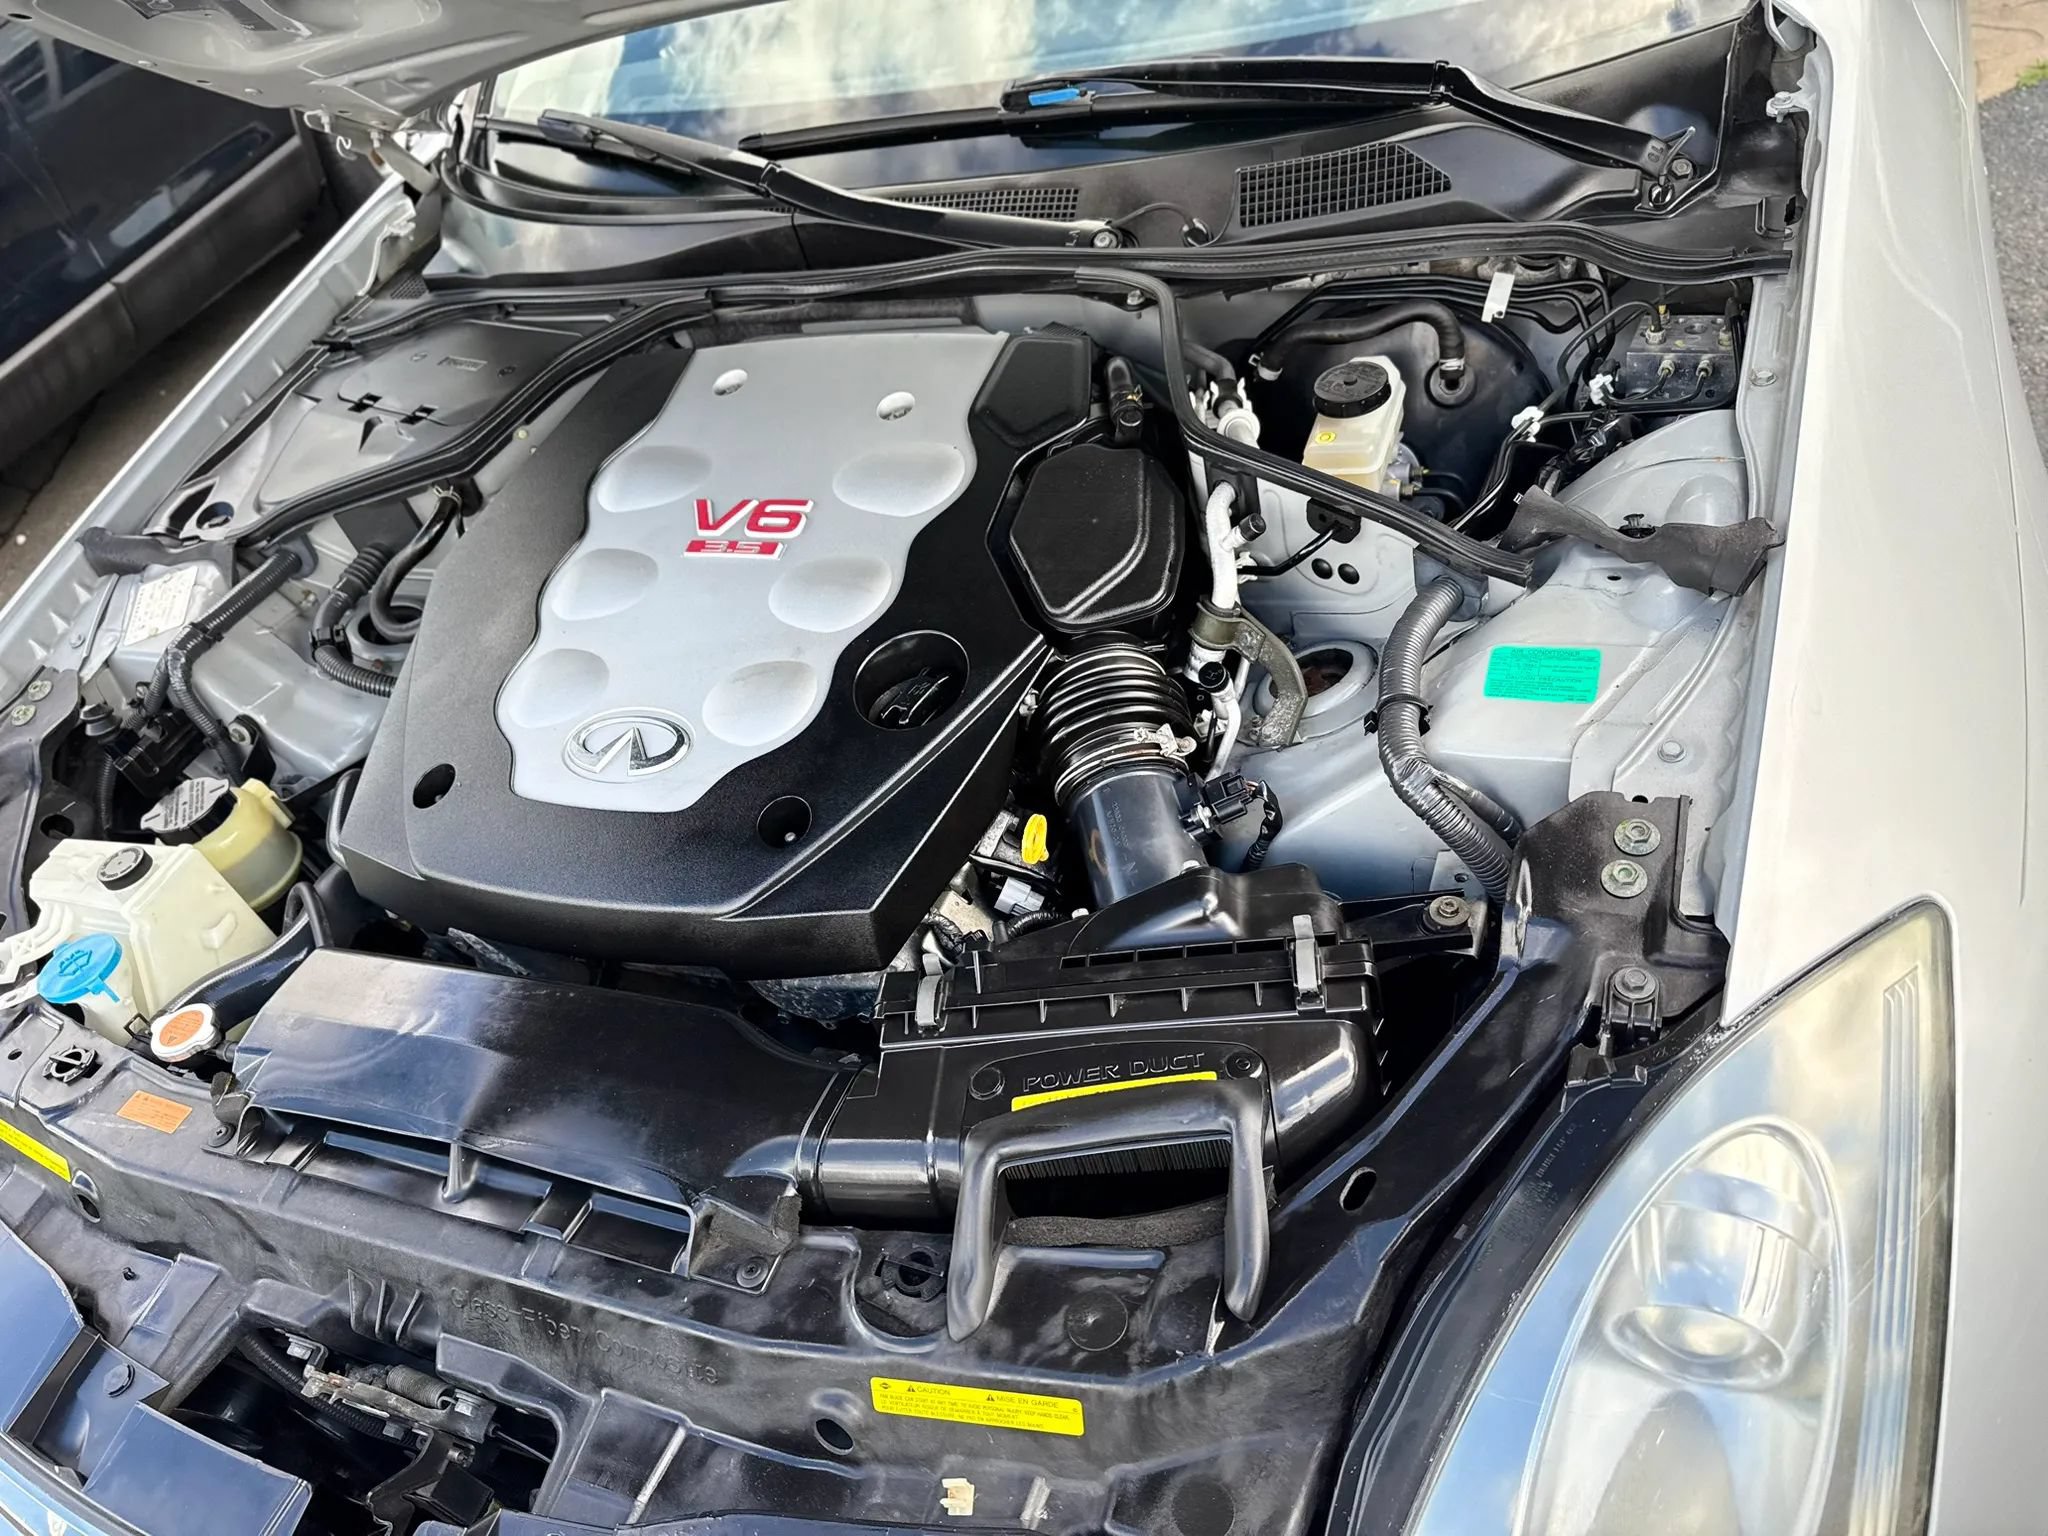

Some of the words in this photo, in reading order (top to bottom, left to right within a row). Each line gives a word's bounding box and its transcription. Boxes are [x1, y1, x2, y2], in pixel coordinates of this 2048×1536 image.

[693, 498, 815, 539] V6
[700, 540, 762, 554] 3.5
[1527, 648, 1581, 657] CONDITIONER
[1023, 1064, 1121, 1093] POWER
[1128, 1052, 1205, 1077] DUCT
[916, 1386, 950, 1395] CAUTION
[1030, 1399, 1058, 1408] GARDE
